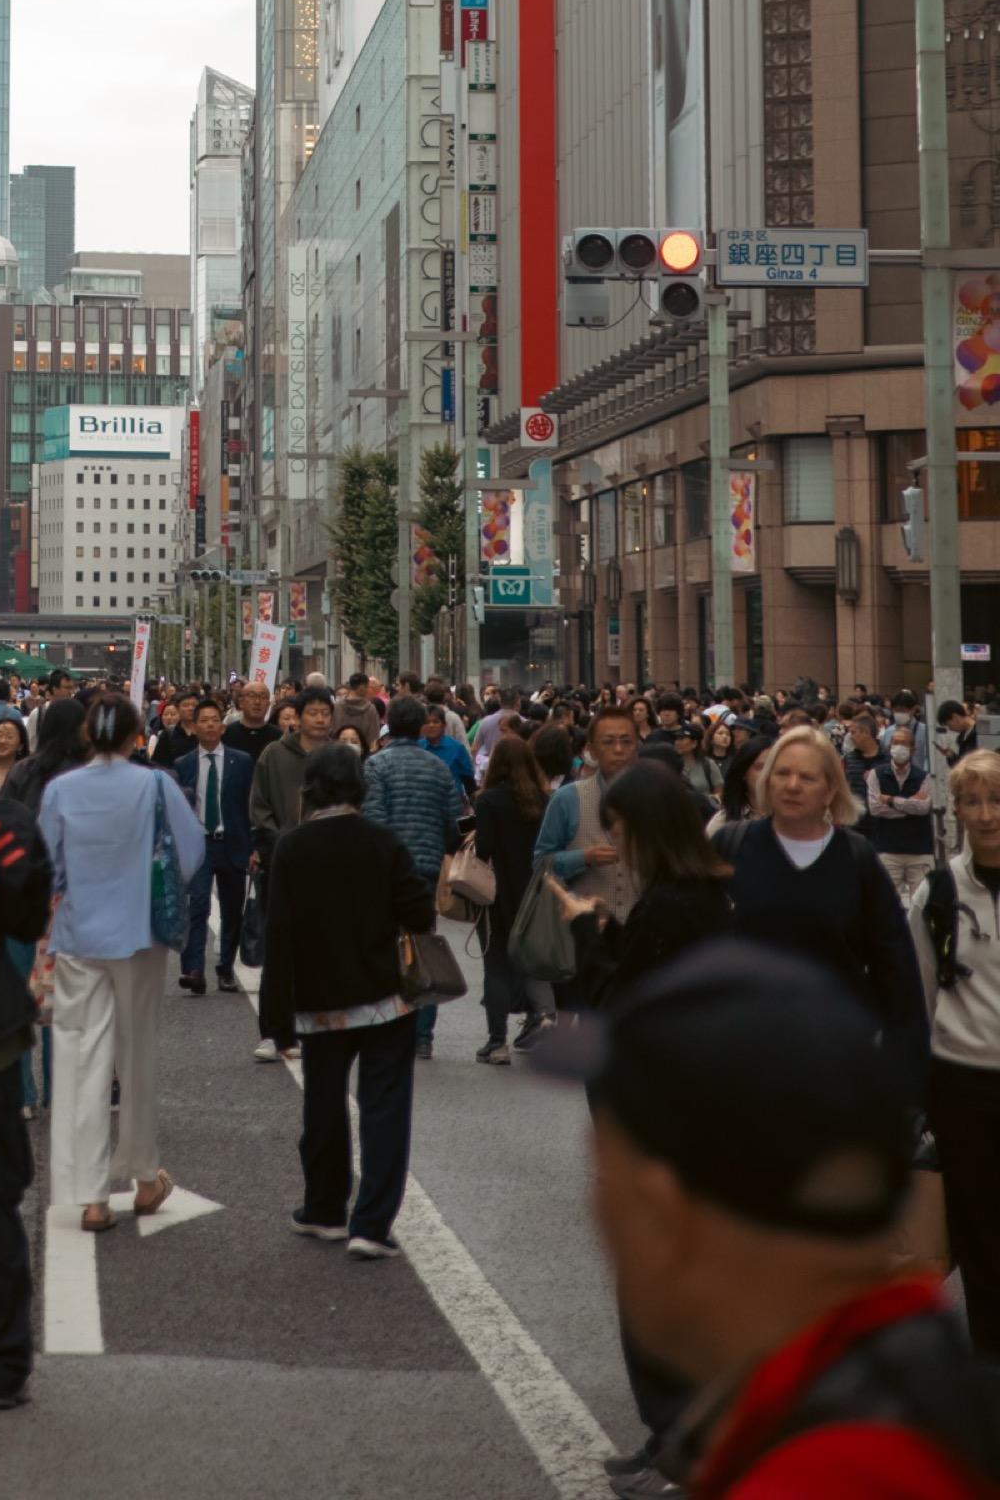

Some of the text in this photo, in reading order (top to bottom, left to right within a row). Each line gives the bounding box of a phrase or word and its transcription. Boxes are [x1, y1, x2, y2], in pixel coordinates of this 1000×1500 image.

[727, 230, 768, 242] 中央区
[728, 243, 857, 266] 銀座四丁目
[766, 267, 818, 280] Ginza 4
[79, 415, 163, 435] Brillia
